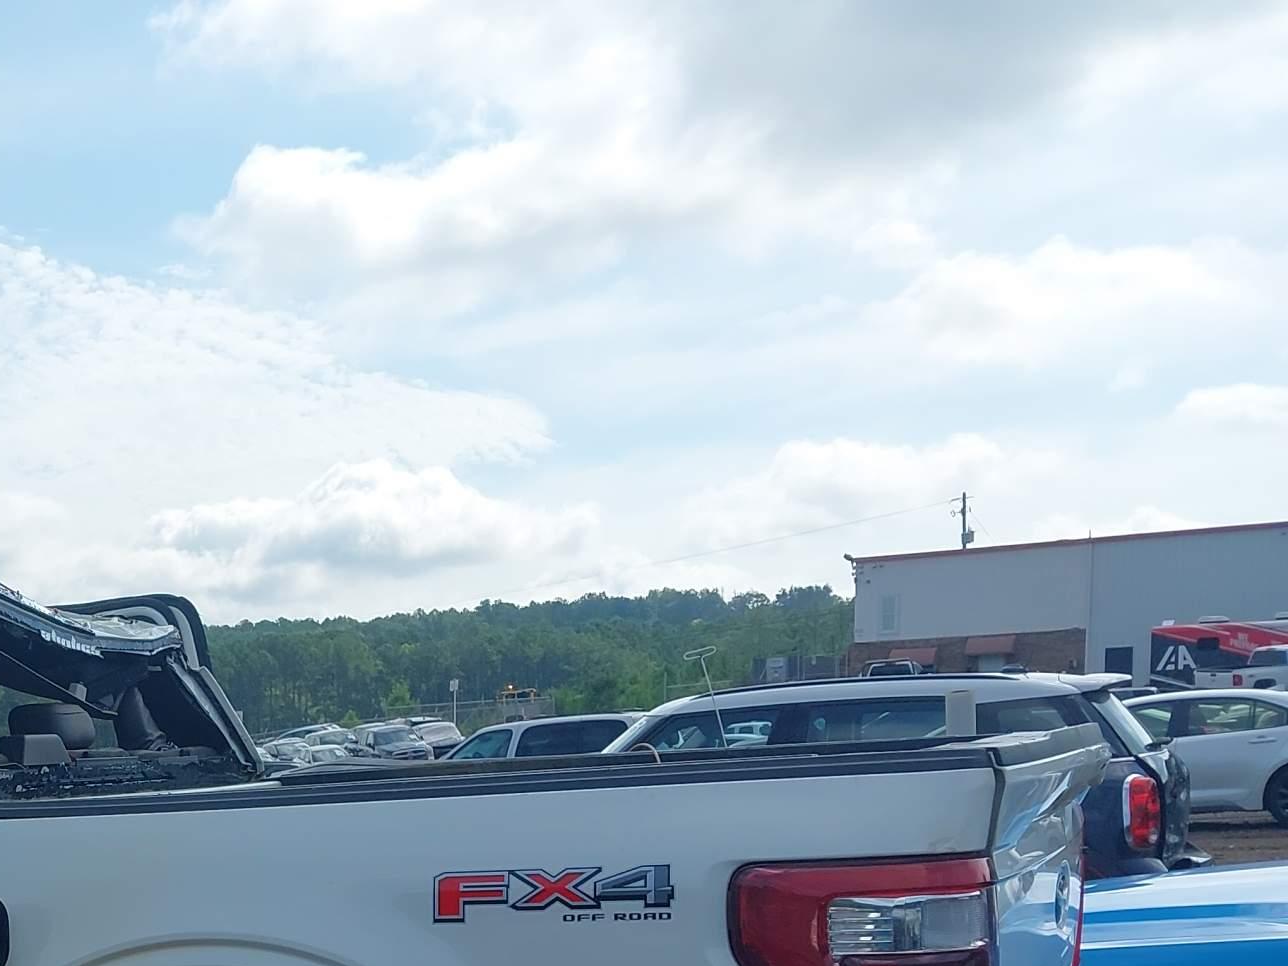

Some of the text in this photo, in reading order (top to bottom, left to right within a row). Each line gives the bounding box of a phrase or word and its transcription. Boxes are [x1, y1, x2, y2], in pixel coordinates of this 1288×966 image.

[433, 864, 675, 923] FX4
[562, 911, 673, 923] OFF ROAD
